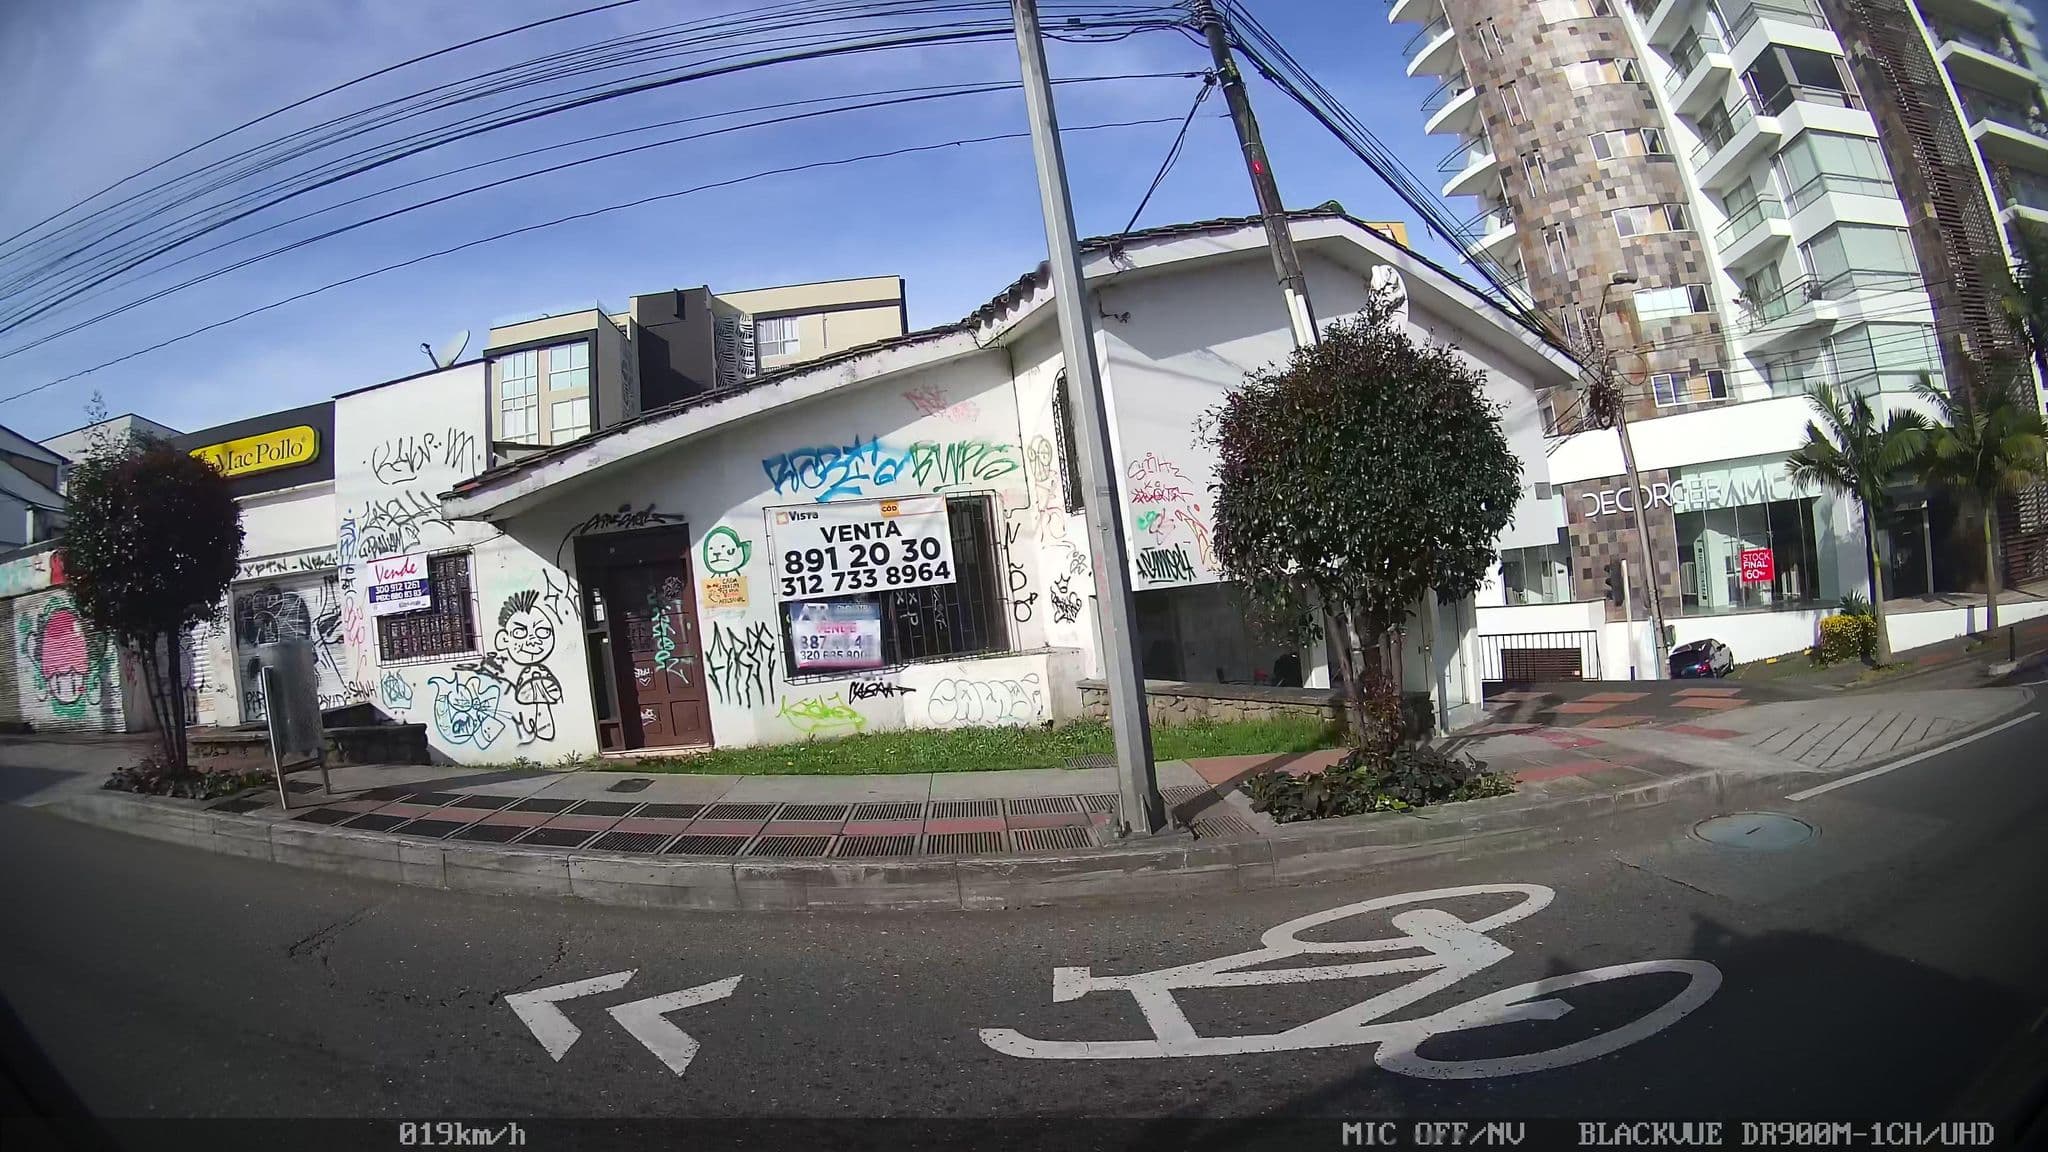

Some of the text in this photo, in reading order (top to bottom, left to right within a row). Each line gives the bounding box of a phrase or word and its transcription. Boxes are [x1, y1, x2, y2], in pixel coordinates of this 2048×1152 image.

[215, 438, 303, 473] Mac Pollo
[820, 520, 902, 543] VENTA
[784, 537, 941, 575] 891 20 30
[1742, 552, 1770, 562] STOCK
[1743, 560, 1769, 569] FINAL
[375, 557, 417, 584] Vende
[781, 560, 951, 597] 312 733 8964
